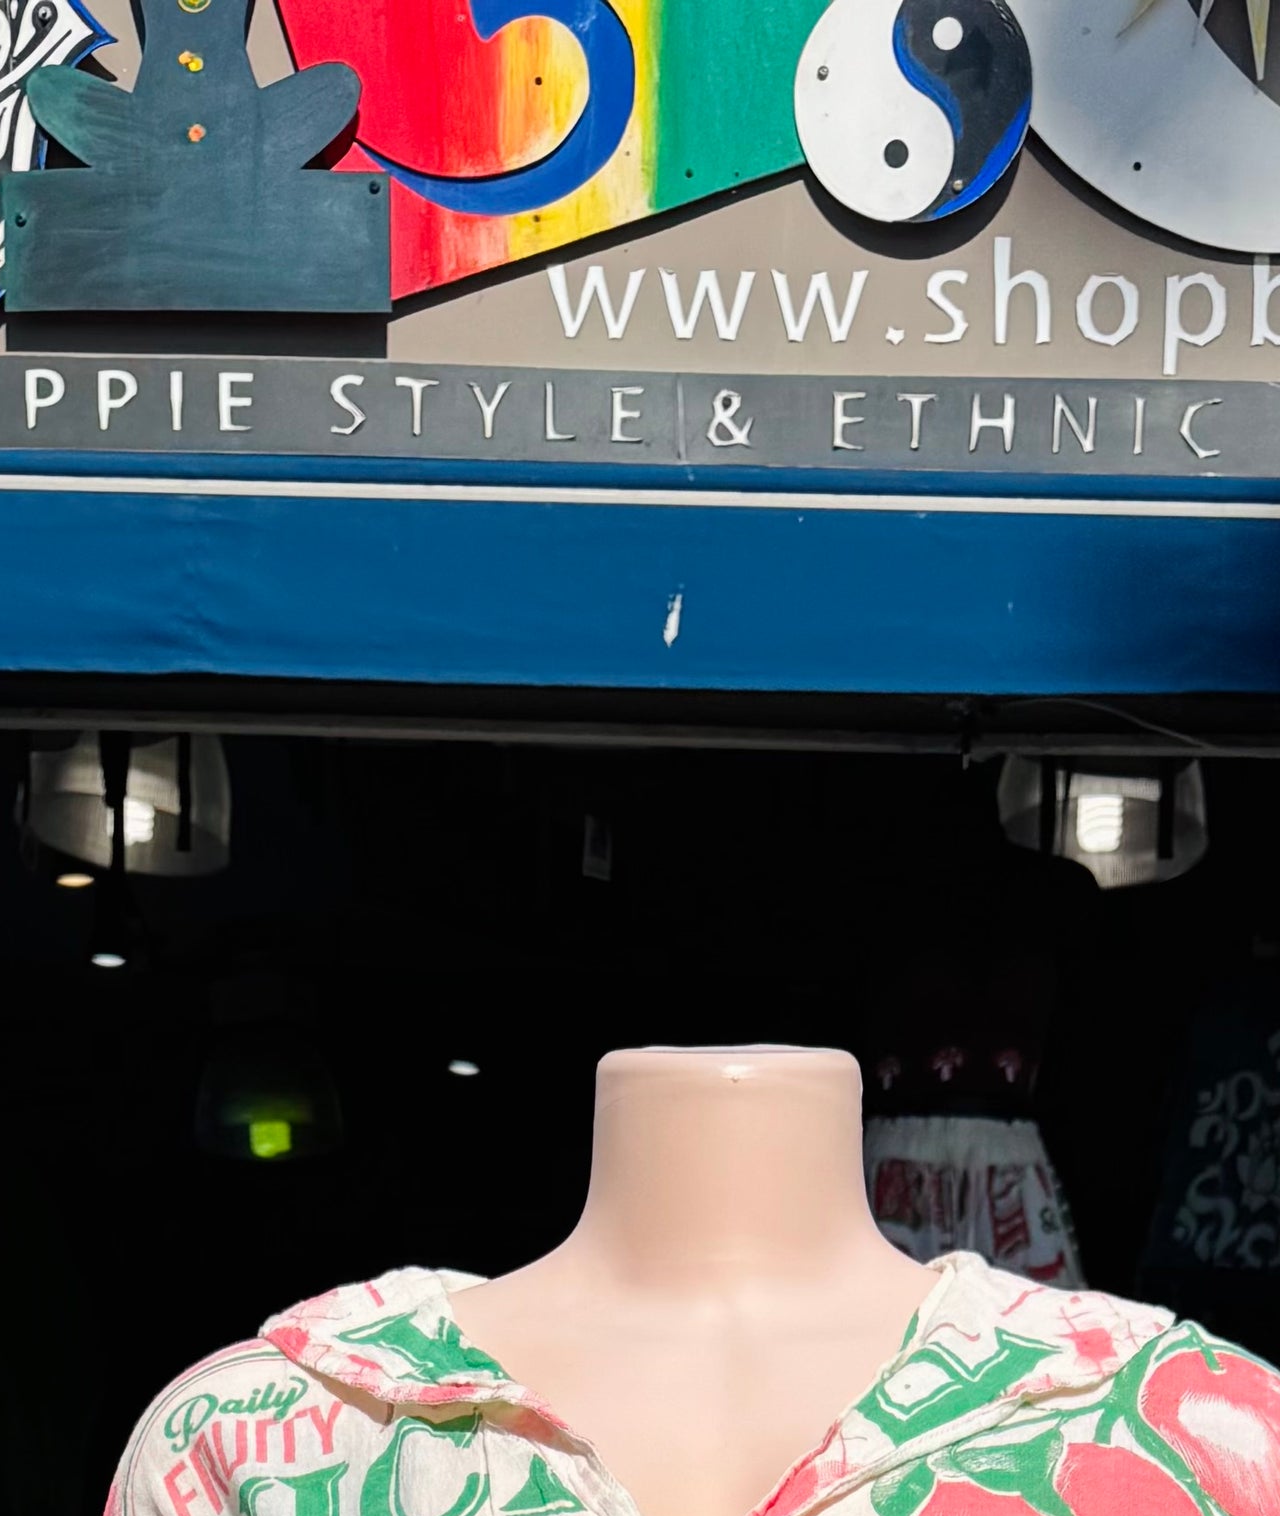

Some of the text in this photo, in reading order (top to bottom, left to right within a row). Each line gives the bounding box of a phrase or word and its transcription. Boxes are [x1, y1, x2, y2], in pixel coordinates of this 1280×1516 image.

[328, 372, 644, 444] STYLE
[706, 390, 754, 448] &
[833, 392, 1223, 460] ETHNIC
[163, 1376, 309, 1453] Daily
